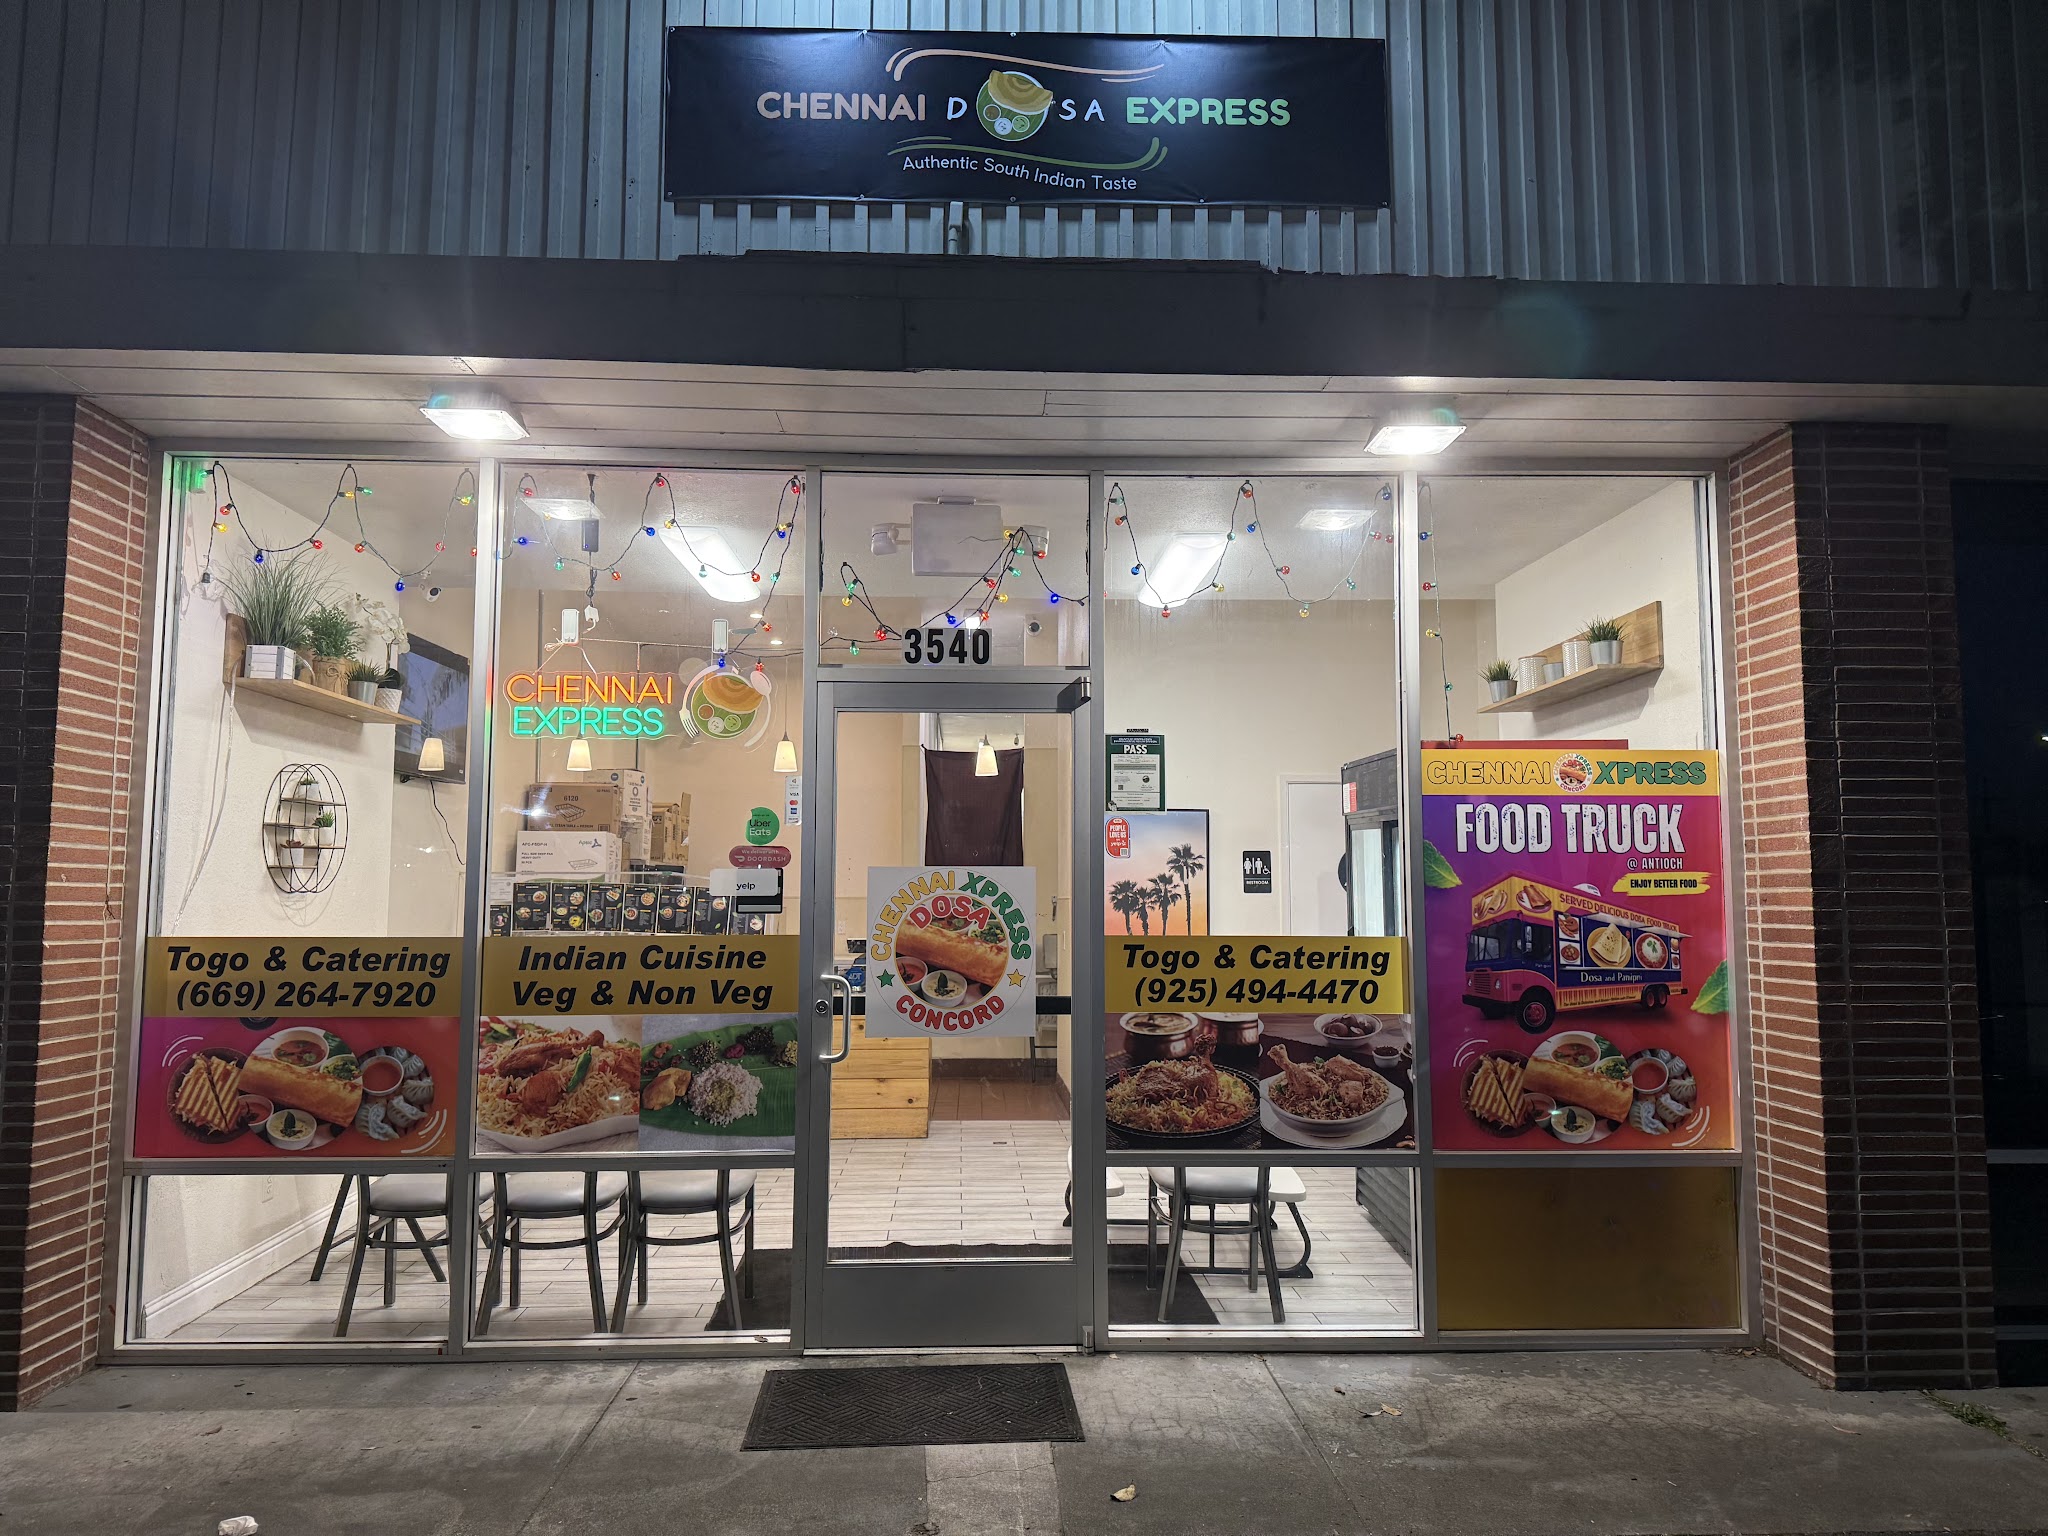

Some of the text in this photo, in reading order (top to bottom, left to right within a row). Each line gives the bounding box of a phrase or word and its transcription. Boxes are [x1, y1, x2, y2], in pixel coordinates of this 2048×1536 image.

[756, 91, 926, 121] CHENNAI
[1126, 96, 1291, 126] EXPRESS
[902, 154, 1137, 190] Authentic South Indian Taste
[904, 628, 990, 664] 3540
[506, 673, 673, 704] CHENNAI
[513, 705, 664, 736] EXPRESS
[1123, 744, 1148, 754] PASS
[1426, 760, 1707, 785] CHENNAI XPRESS
[749, 819, 771, 828] Uber
[749, 828, 771, 836] Eats
[1455, 803, 1686, 854] FOOD TRUCK
[1642, 857, 1683, 870] ANTIOCH
[736, 882, 756, 891] yelp
[1630, 879, 1697, 888] ENJOY BETTER FOOD
[871, 870, 1032, 961] CHENNAI XPRESS
[909, 895, 991, 930] DOSA
[1559, 893, 1594, 910] SERVED
[1594, 903, 1629, 920] DELICIOUS
[1646, 917, 1662, 928] FOOD
[1663, 922, 1678, 932] TRUCK
[167, 946, 450, 978] Togo & Catering
[518, 944, 767, 970] Indian Cuisine
[1123, 944, 1390, 976] Togo & Catering
[1135, 977, 1379, 1007] (925) 494-4470
[1580, 972, 1602, 983] Dosa
[1604, 972, 1616, 982] and
[177, 980, 436, 1010] (669) 264-7920
[513, 979, 773, 1012] Veg & Non Veg
[896, 995, 1005, 1031] CONCORD
